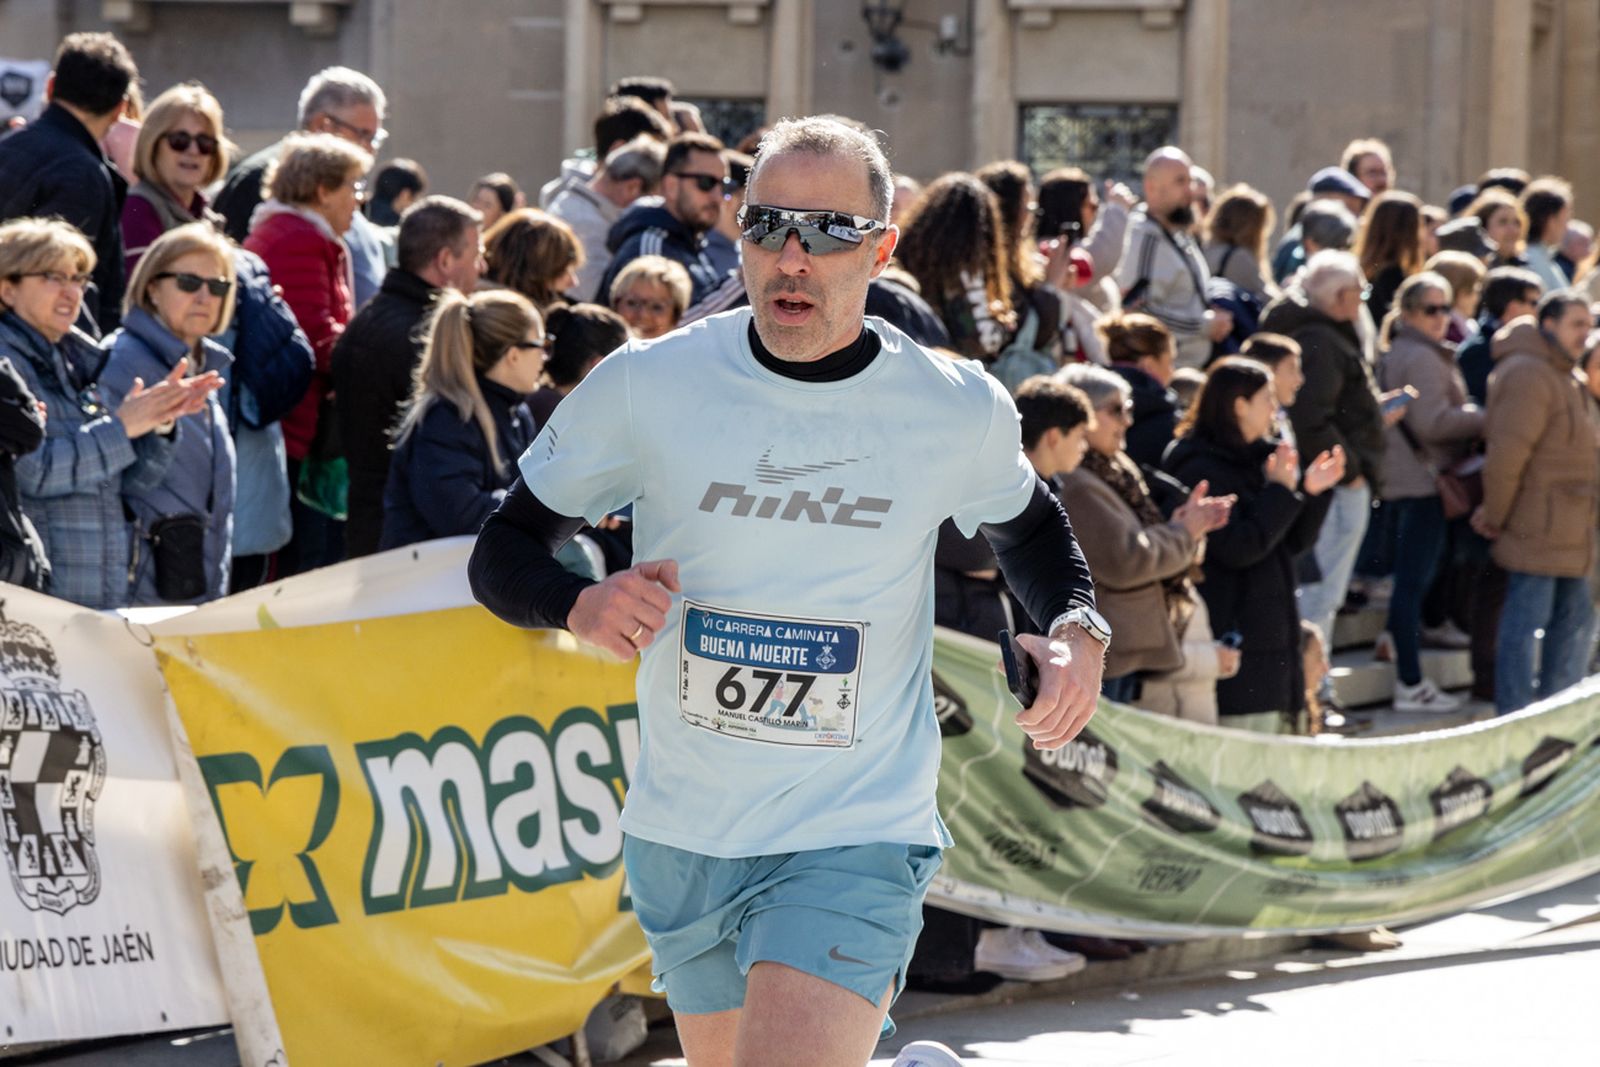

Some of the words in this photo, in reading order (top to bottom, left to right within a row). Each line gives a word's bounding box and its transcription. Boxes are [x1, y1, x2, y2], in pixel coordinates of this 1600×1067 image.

[700, 634, 745, 659] BUENA
[750, 643, 809, 666] MUERTE
[702, 617, 713, 629] VI
[716, 620, 772, 638] CARRERA
[775, 626, 840, 644] CAMINATA
[716, 666, 817, 717] 677
[718, 709, 748, 721] MANUEL
[748, 714, 782, 727] CASTILLO
[358, 705, 641, 913] mas
[0, 937, 65, 971] IUDAD
[67, 935, 96, 966] DE
[101, 924, 155, 965] JAÉN
